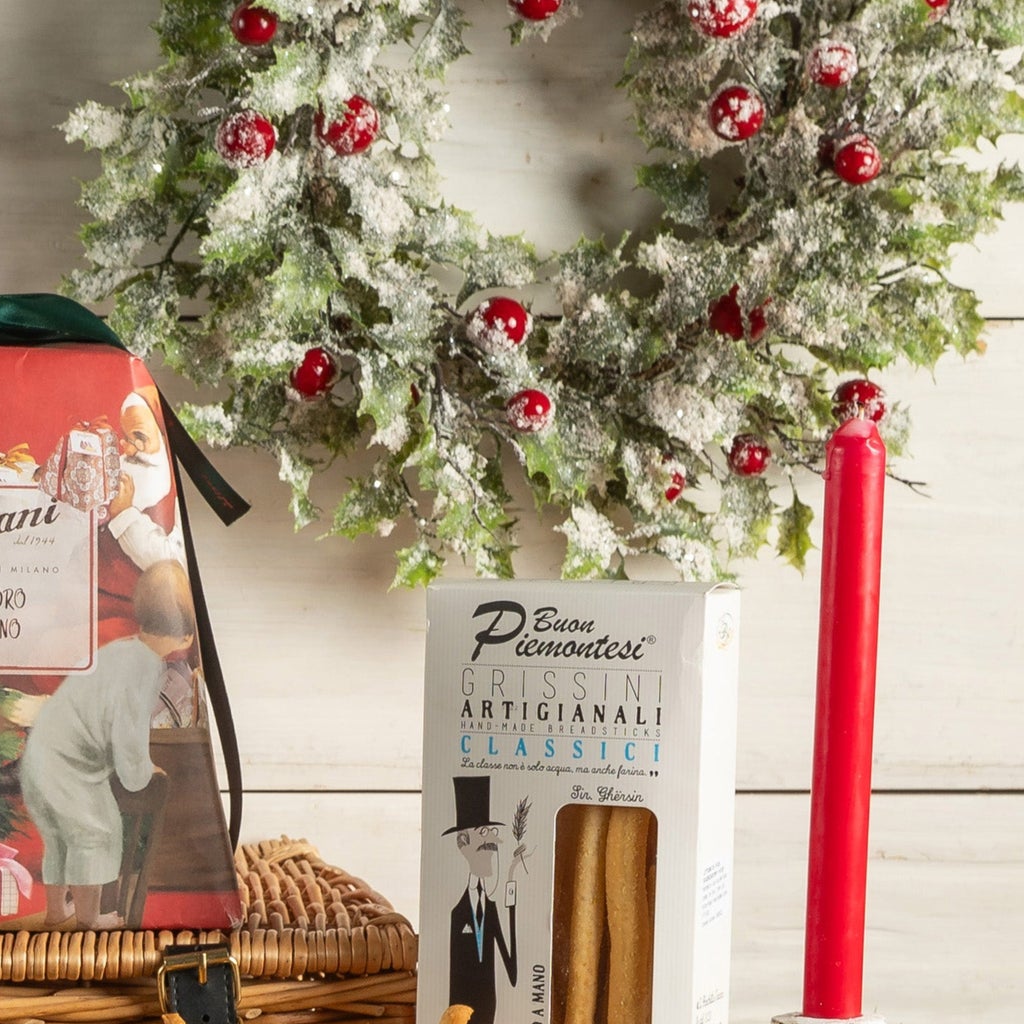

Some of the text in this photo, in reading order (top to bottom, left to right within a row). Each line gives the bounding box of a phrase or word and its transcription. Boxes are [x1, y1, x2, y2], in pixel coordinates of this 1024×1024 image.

[10, 566, 60, 574] MILANO
[533, 606, 595, 633] Buon
[461, 668, 662, 703] GRISSINI
[460, 699, 662, 726] ARTIGIANALI
[460, 720, 662, 738] HAND-MADE BREADSTICKS
[460, 734, 660, 762] CLASSICI
[460, 757, 474, 768] La
[476, 758, 502, 770] classe
[526, 761, 544, 772] solo
[576, 766, 590, 774] ma
[591, 764, 616, 775] anche
[532, 964, 546, 1004] MANO
[532, 1008, 544, 1017] A
